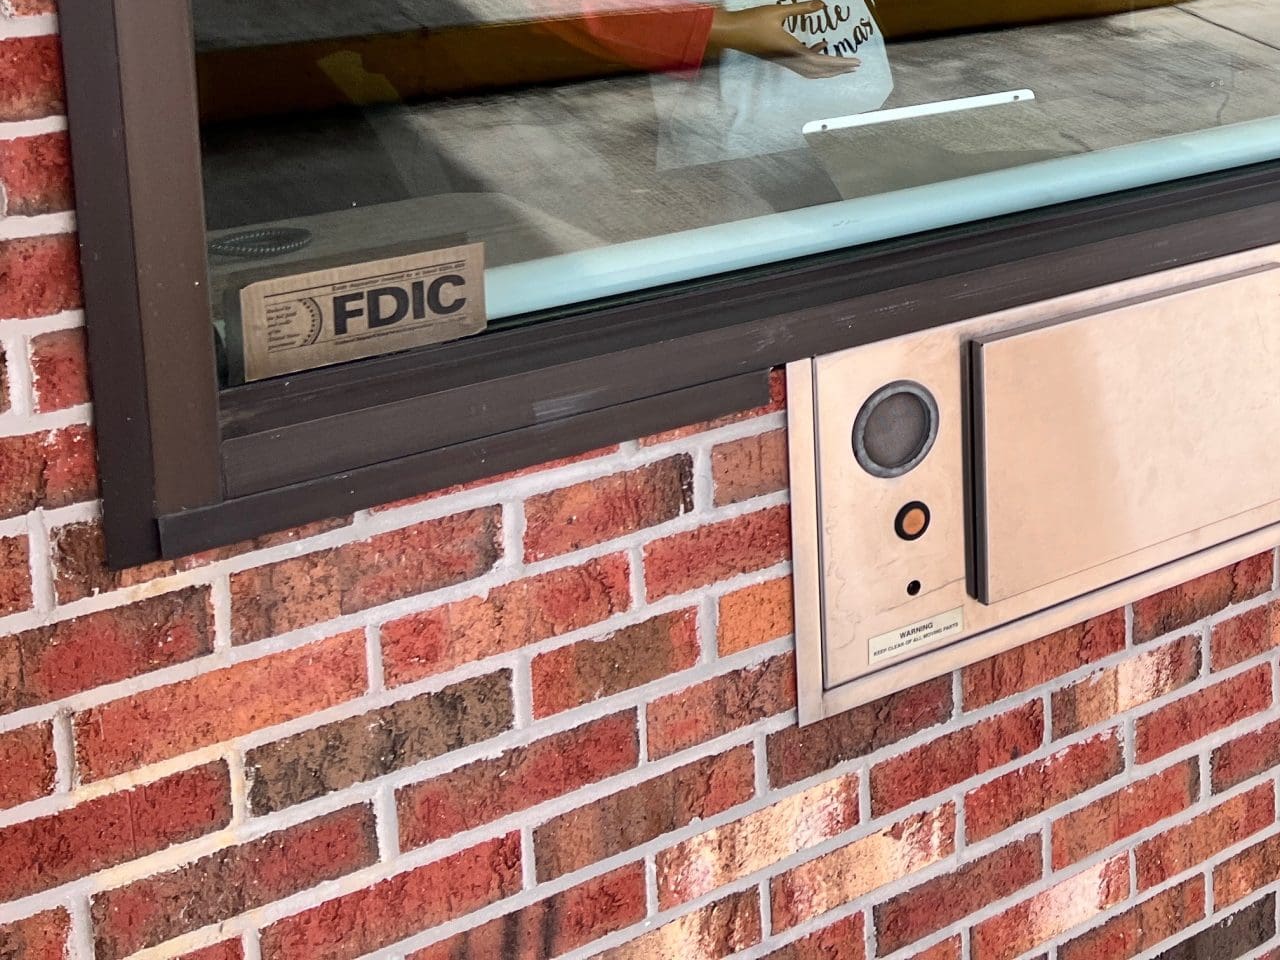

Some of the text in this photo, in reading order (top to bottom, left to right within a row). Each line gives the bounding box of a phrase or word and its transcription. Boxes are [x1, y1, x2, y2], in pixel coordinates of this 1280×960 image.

[333, 274, 466, 336] FDIC
[873, 648, 887, 656] KEEP
[888, 642, 904, 652] CLEAR
[923, 629, 943, 638] MOVING
[943, 622, 959, 631] PARTS
[899, 622, 934, 639] WARNING
